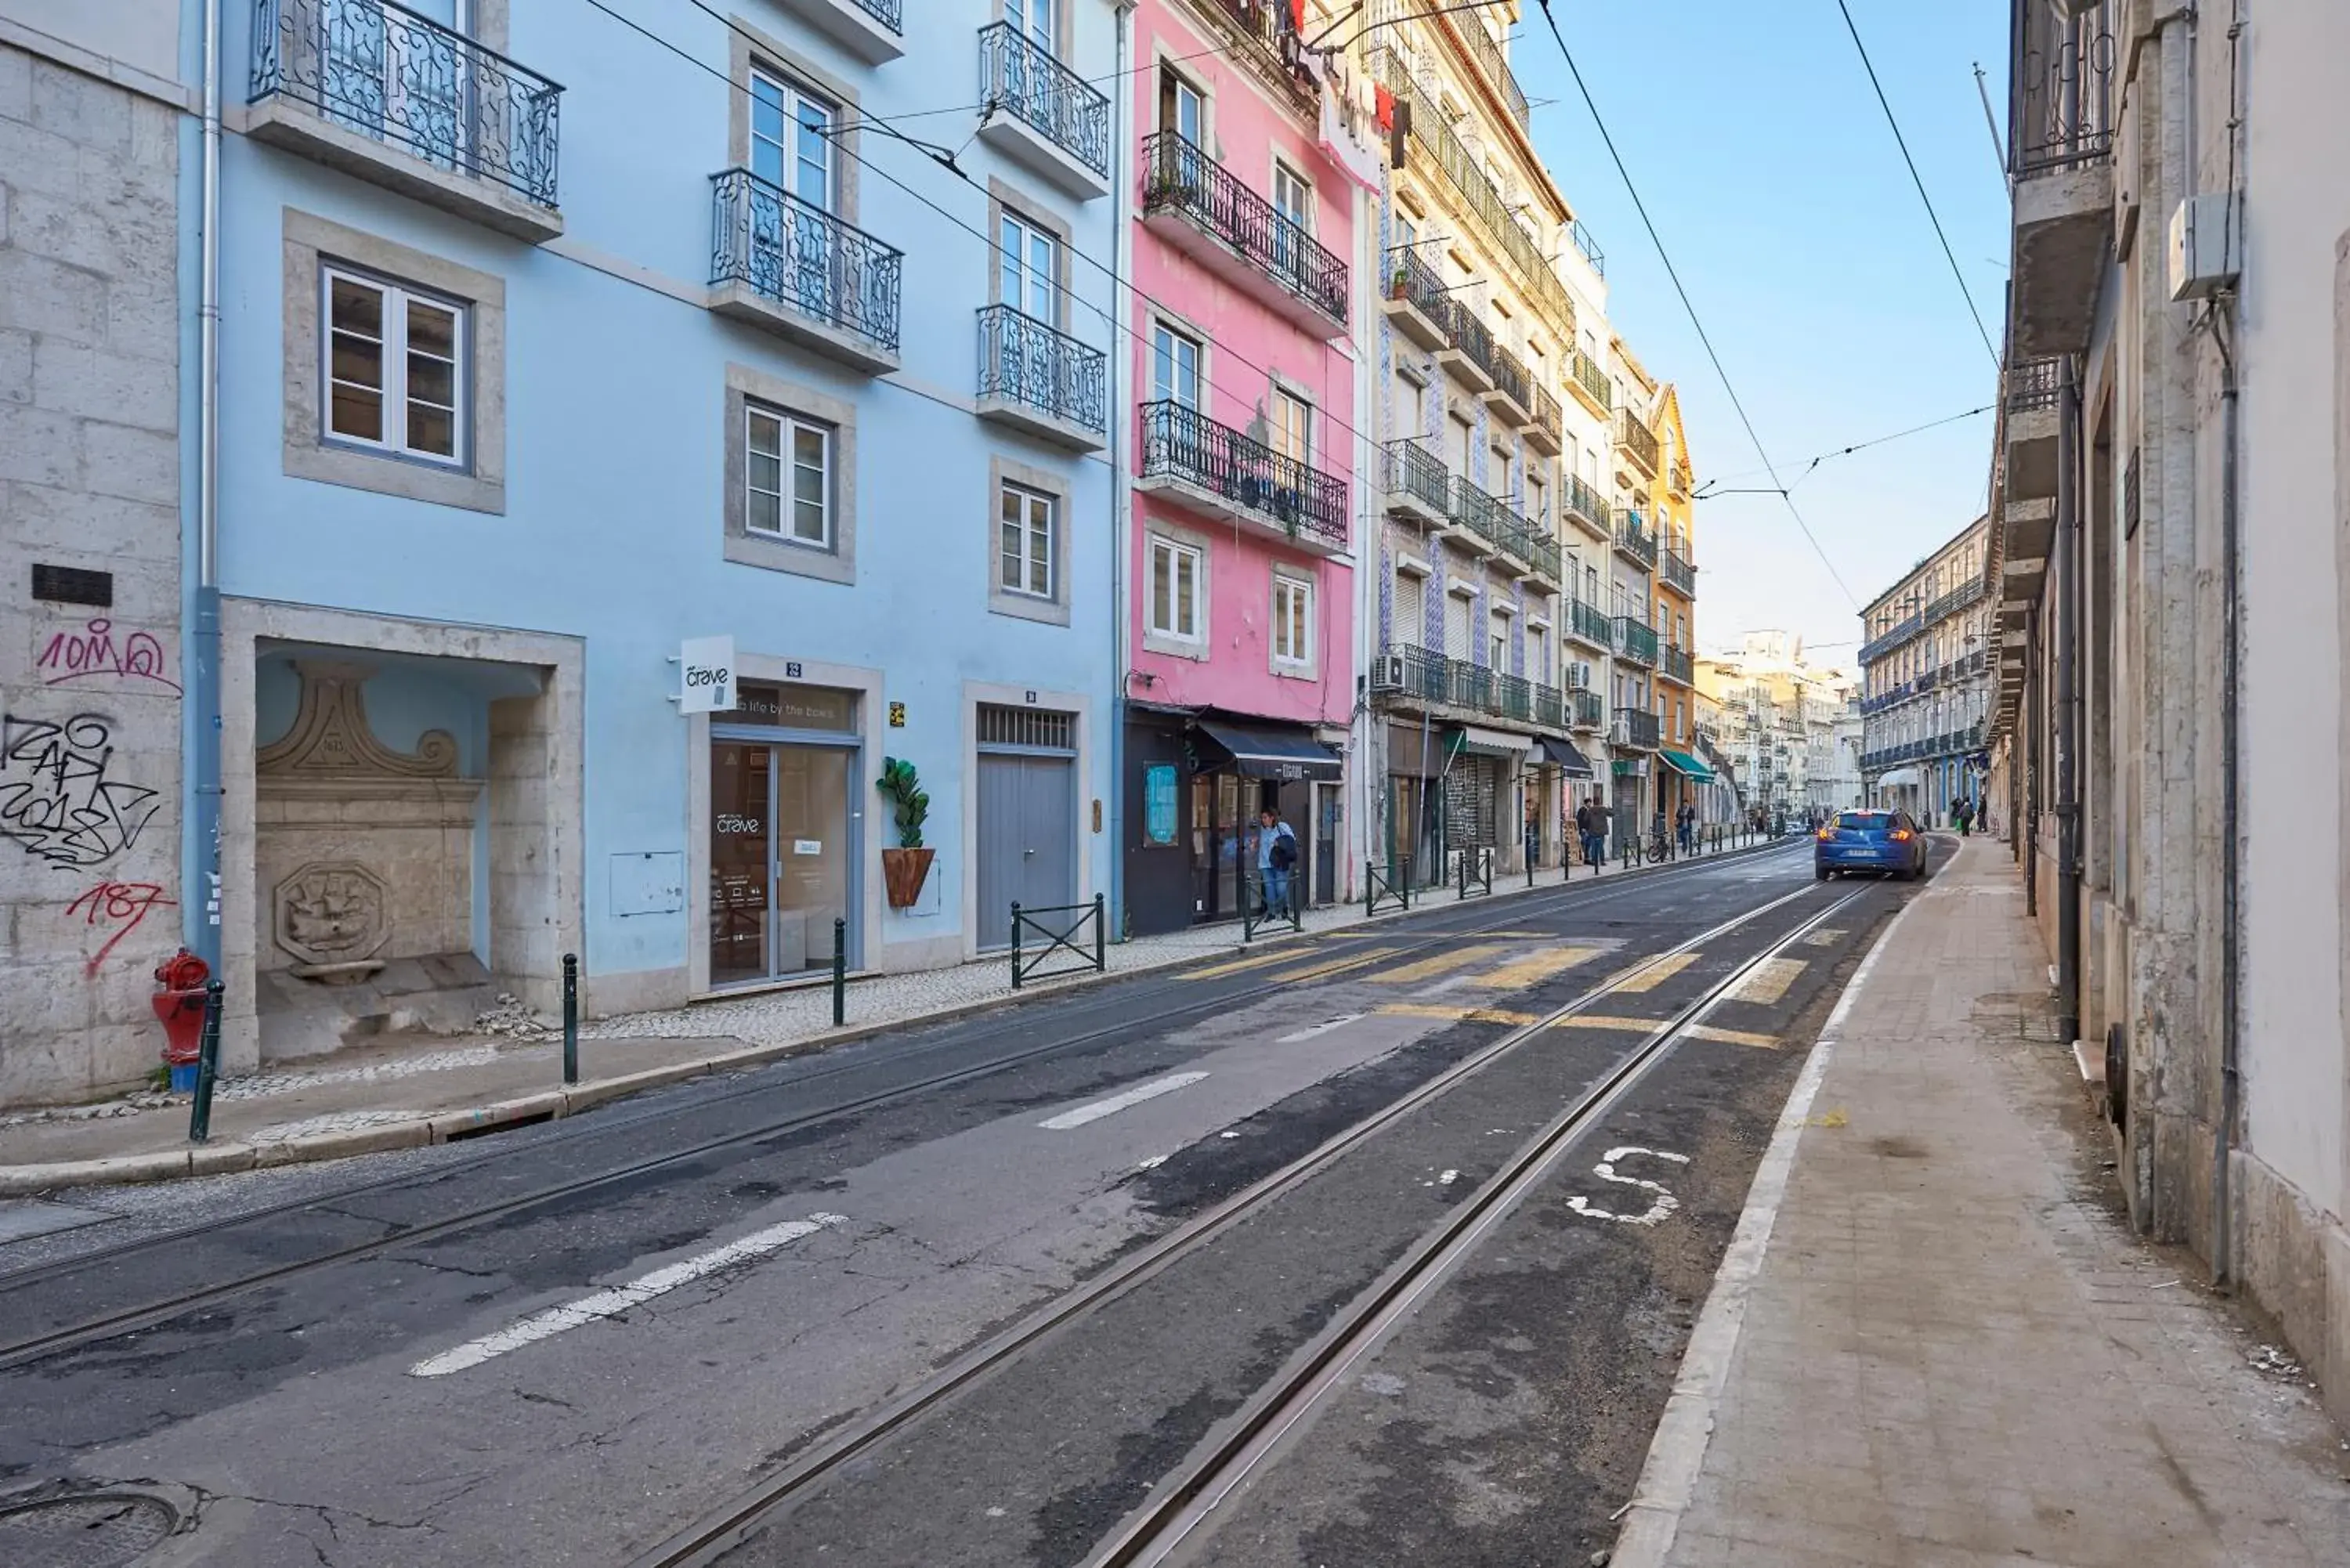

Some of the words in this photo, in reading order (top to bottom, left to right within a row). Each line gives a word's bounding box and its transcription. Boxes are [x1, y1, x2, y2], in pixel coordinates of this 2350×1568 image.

[687, 667, 728, 687] crave
[770, 702, 783, 716] by
[717, 818, 759, 833] crave
